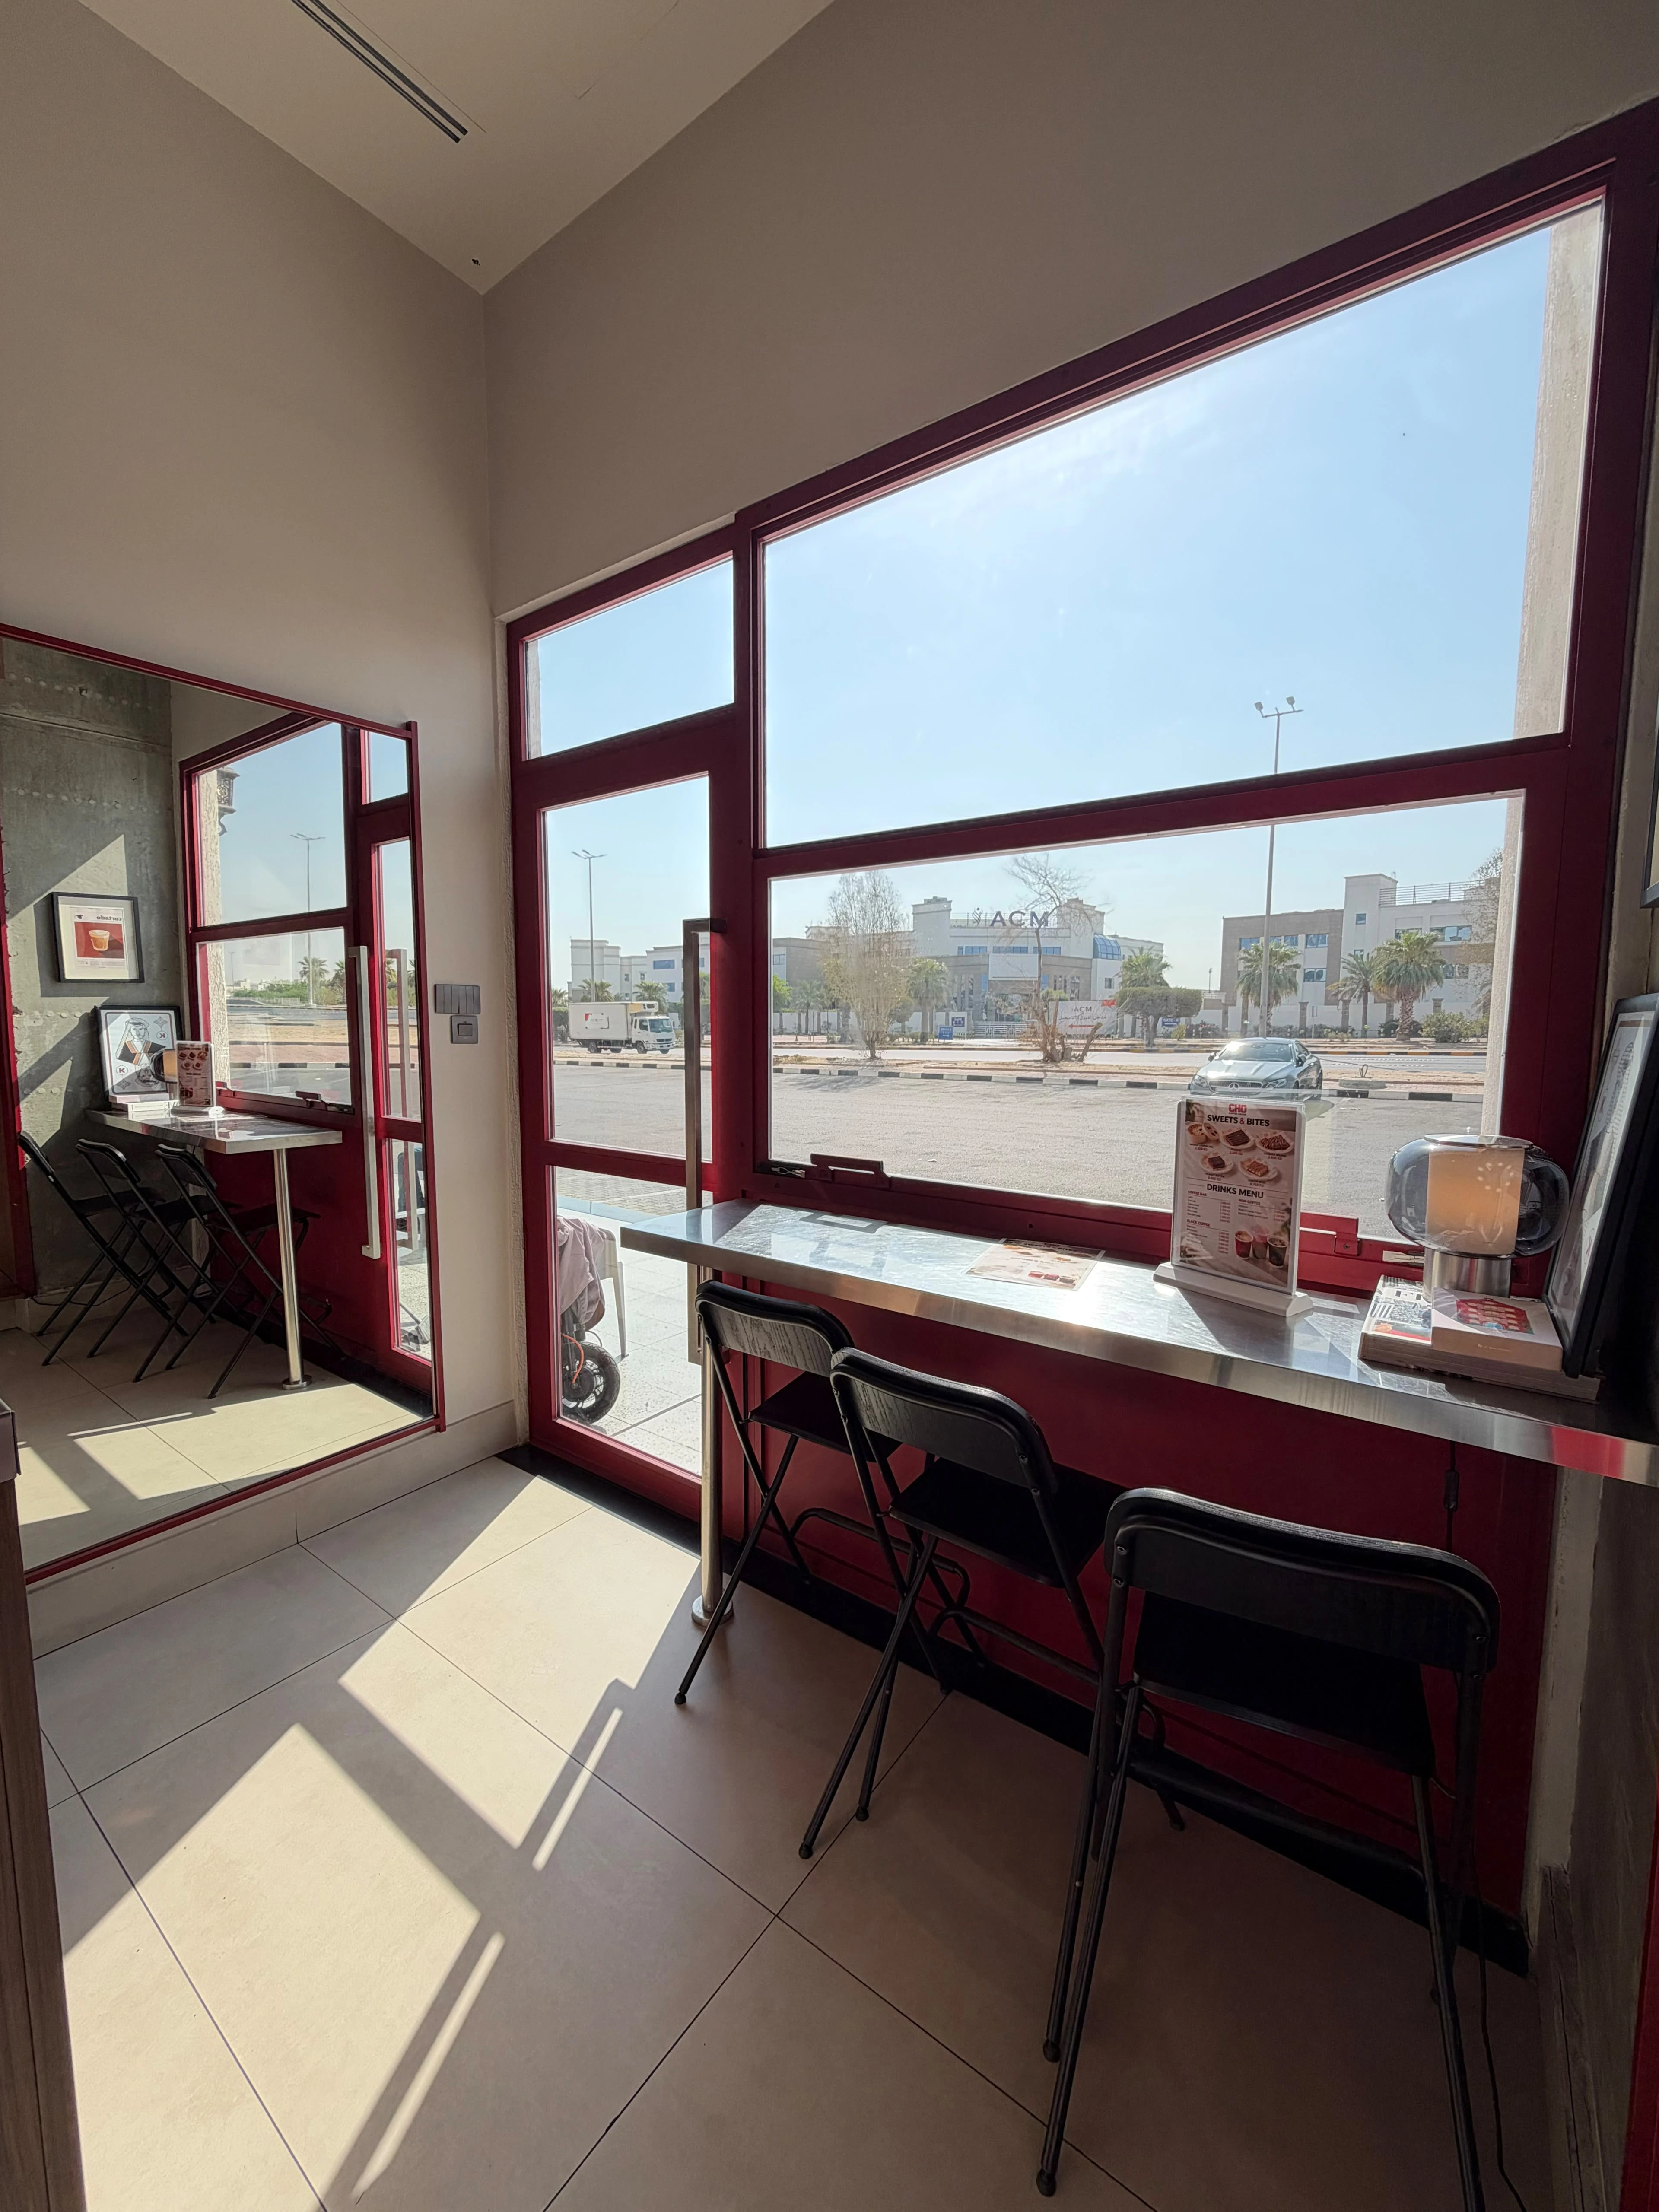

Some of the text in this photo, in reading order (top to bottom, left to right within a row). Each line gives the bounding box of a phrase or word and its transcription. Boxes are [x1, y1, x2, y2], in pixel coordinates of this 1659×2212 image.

[989, 910, 1049, 927] ACM
[1229, 1103, 1247, 1113] CHO
[1207, 1114, 1238, 1124] SWEETS
[1246, 1118, 1270, 1127] BITES
[1207, 1183, 1264, 1198] DRINKS MENU
